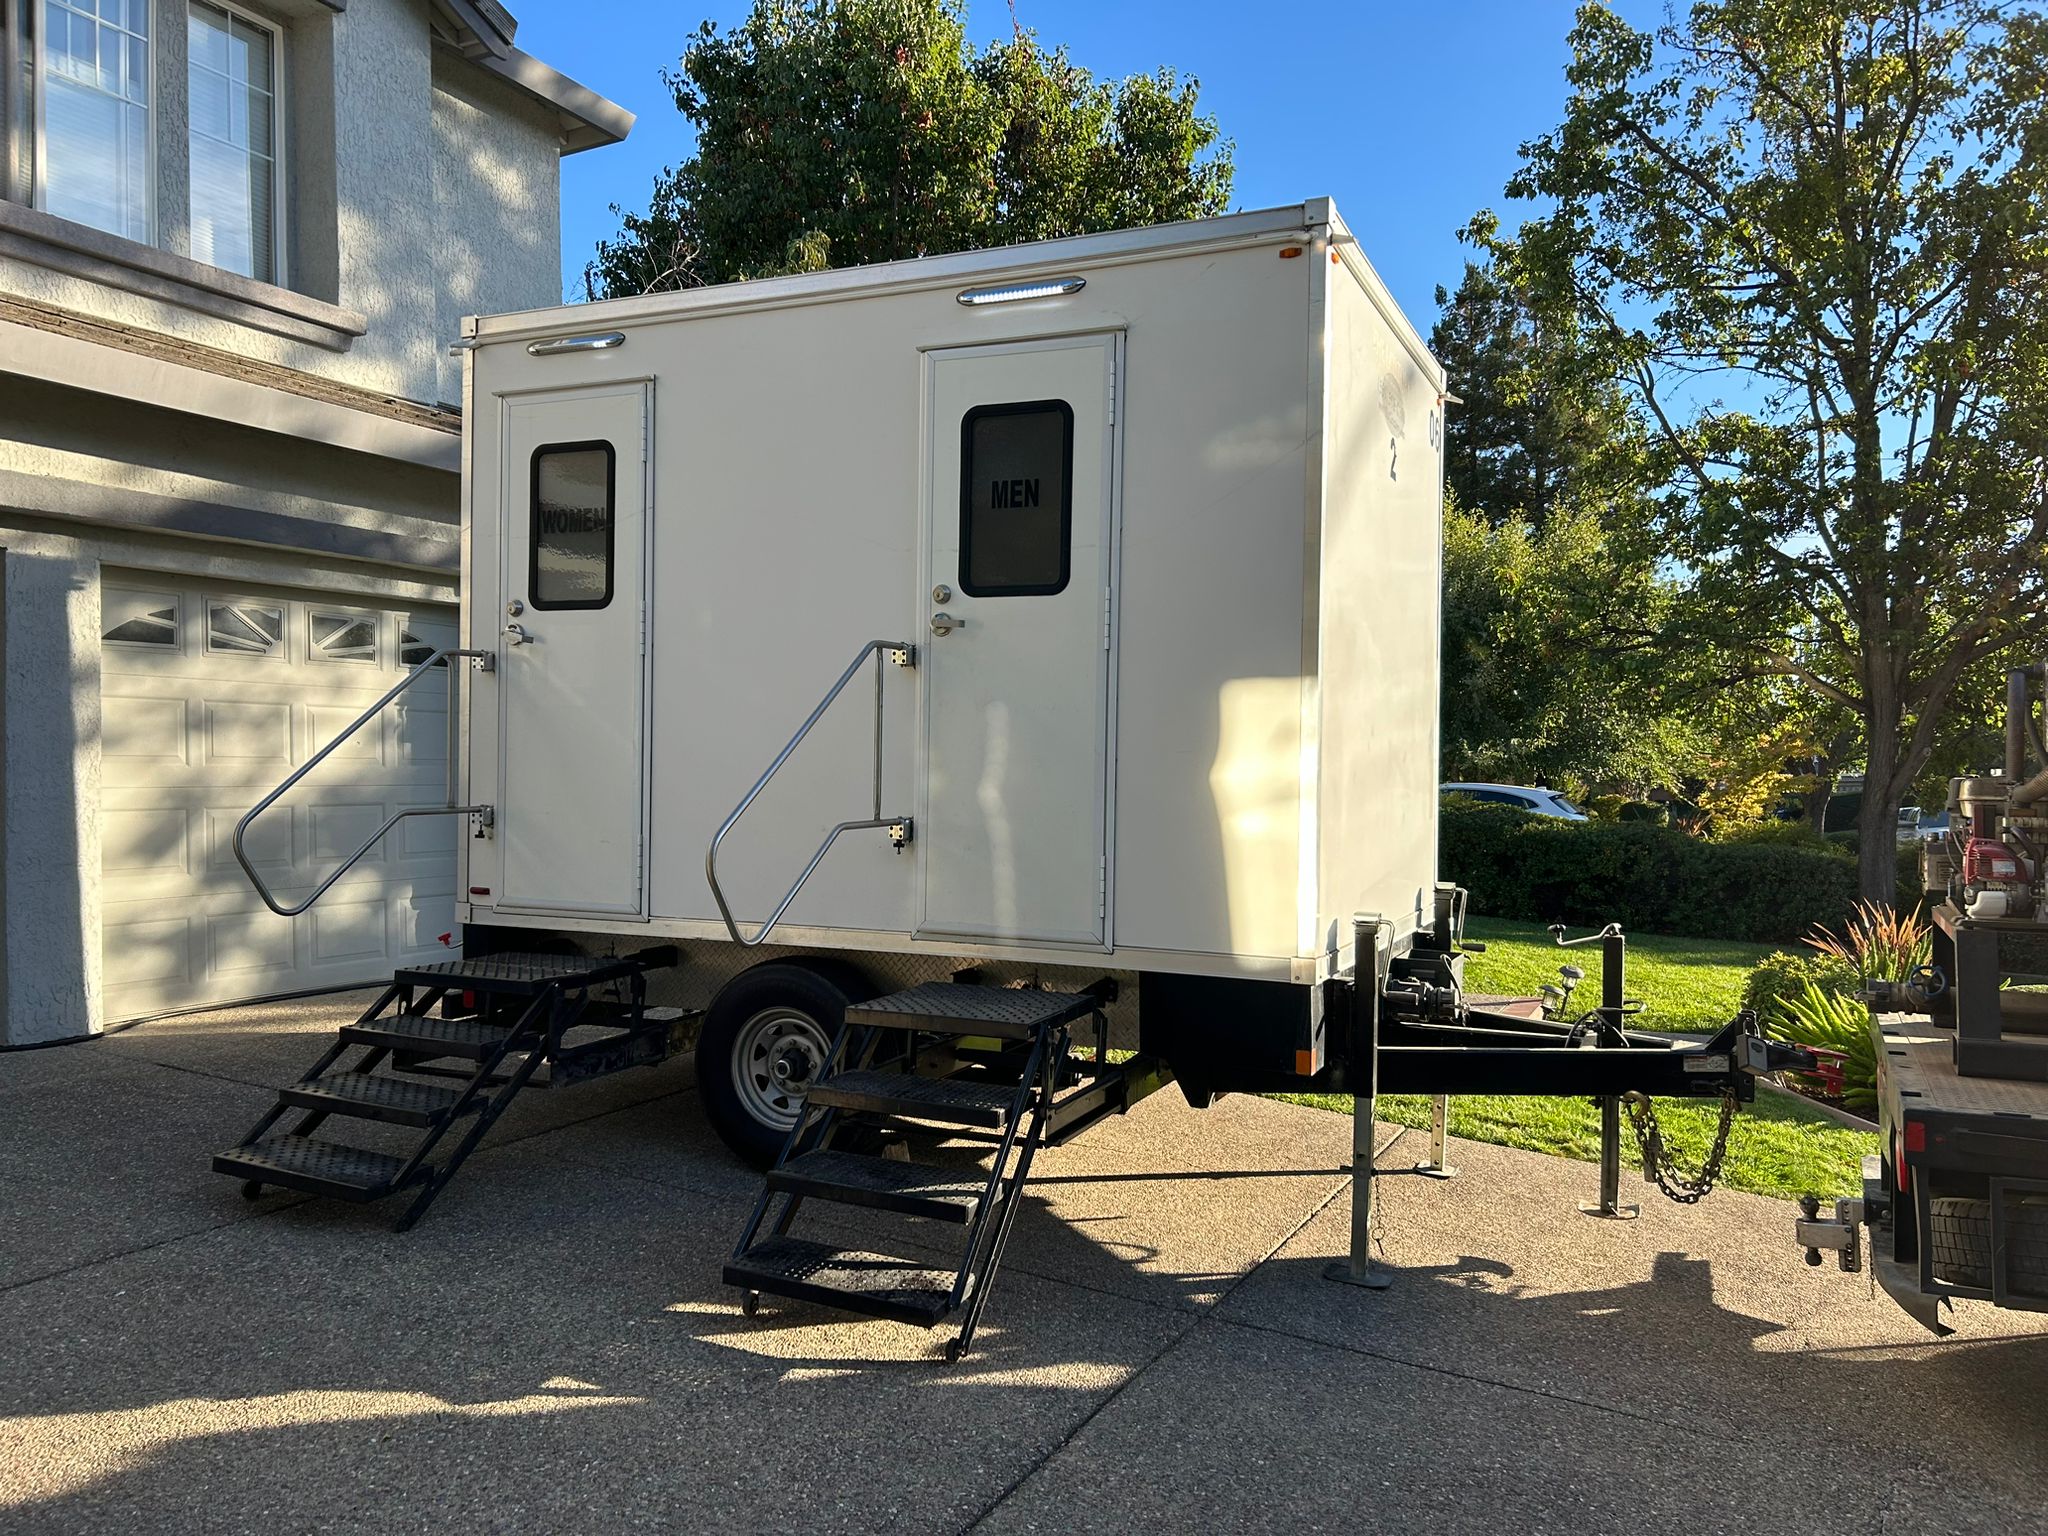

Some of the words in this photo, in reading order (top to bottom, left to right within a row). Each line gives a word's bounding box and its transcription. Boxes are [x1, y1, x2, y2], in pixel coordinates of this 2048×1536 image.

[1390, 437, 1397, 482] 2
[991, 478, 1040, 509] MEN
[541, 506, 606, 535] WOMEN
